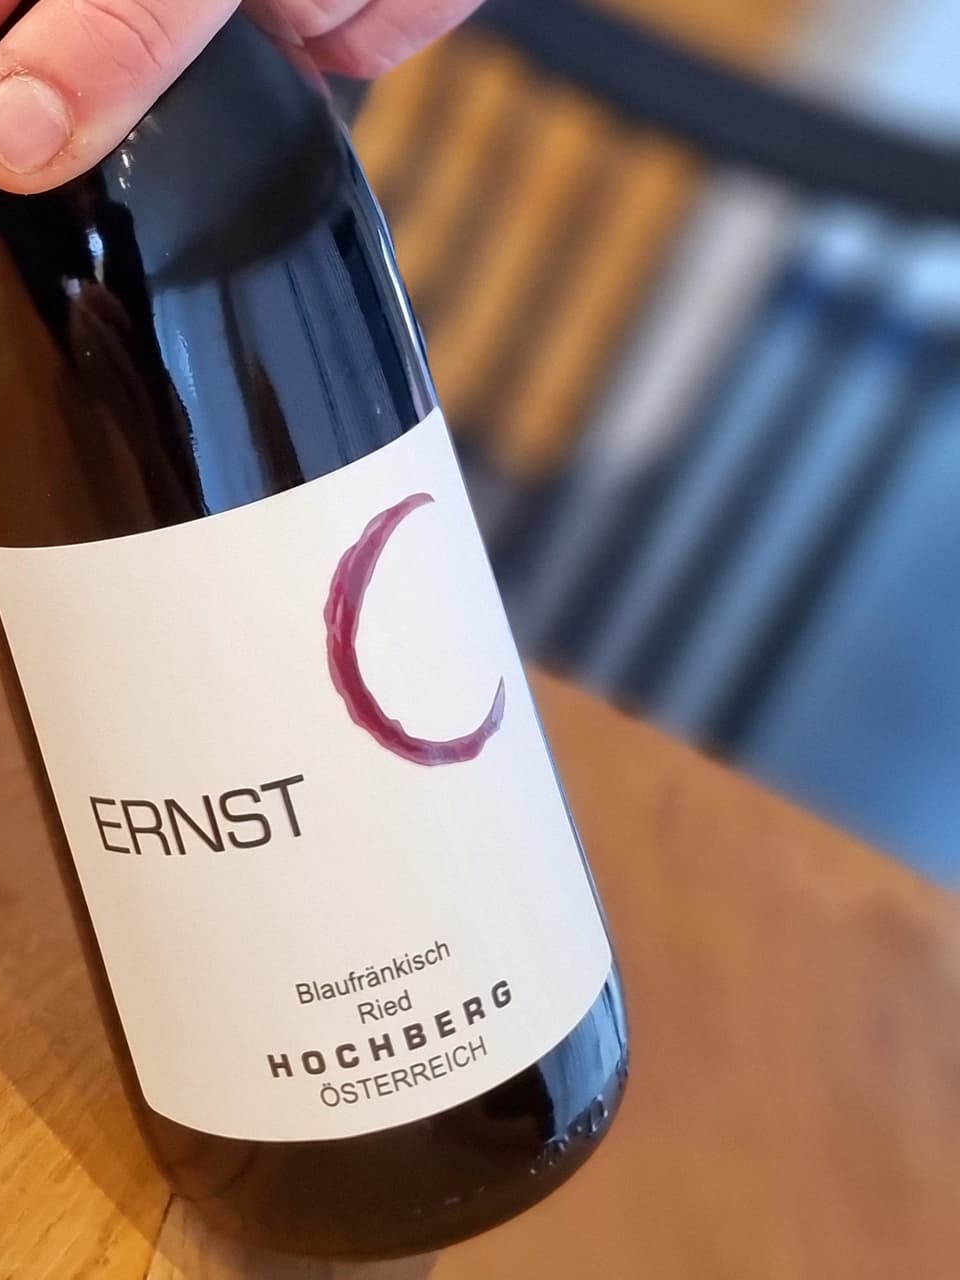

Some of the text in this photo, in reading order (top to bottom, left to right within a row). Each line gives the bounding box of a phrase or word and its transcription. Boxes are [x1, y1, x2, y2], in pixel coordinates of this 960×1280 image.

[89, 774, 304, 855] ERNST
[295, 941, 451, 1004] Blaufränkisch
[357, 989, 413, 1024] Ried
[267, 980, 512, 1078] HOCHBERG
[320, 1035, 488, 1108] ÖSTERREICH
